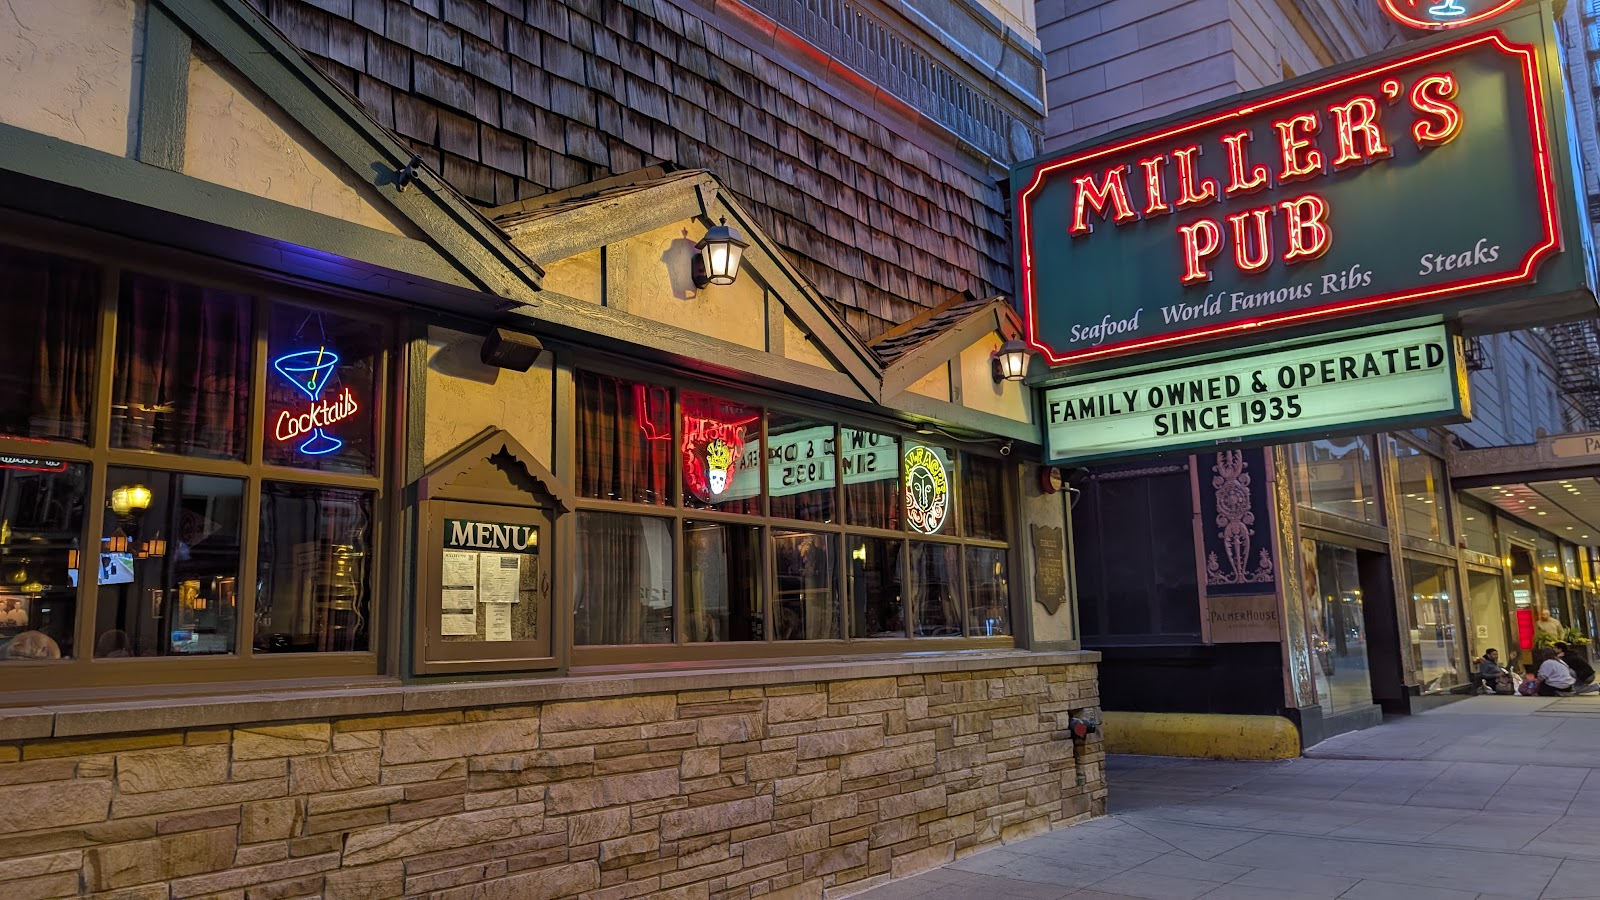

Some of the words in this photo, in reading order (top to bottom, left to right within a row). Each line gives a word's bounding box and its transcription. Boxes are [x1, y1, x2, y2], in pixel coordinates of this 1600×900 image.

[1067, 72, 1462, 236] MILLER'S
[1177, 195, 1331, 285] PUB
[1418, 238, 1500, 276] Steaks
[1160, 291, 1226, 325] World
[1229, 282, 1312, 312] Famous
[1320, 264, 1372, 296] Ribs
[1069, 308, 1143, 346] Seafood
[1050, 390, 1138, 424] FAMILY
[1148, 375, 1241, 408] OWNED
[1251, 370, 1268, 393] &
[1277, 343, 1444, 390] OPERATED
[276, 388, 358, 441] Cocktails
[1154, 405, 1231, 436] SINCE
[1241, 395, 1302, 424] 1935
[450, 521, 531, 550] MENU
